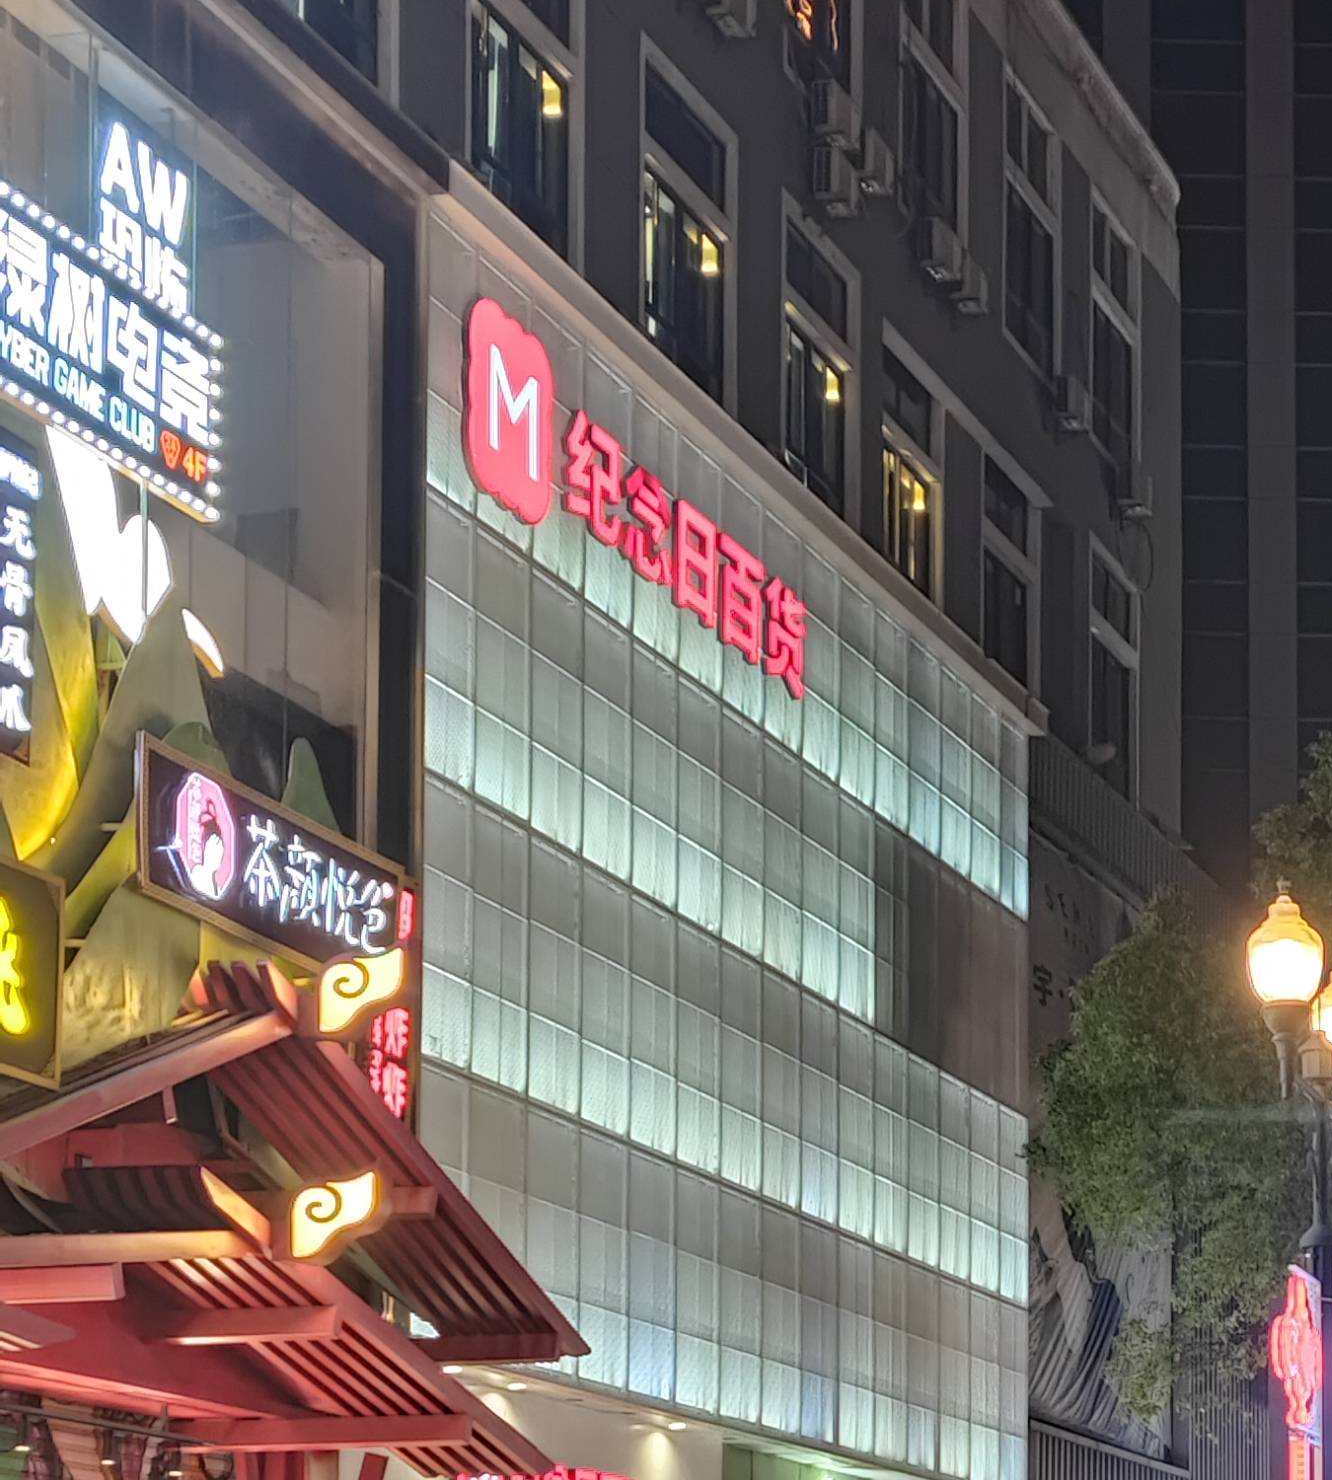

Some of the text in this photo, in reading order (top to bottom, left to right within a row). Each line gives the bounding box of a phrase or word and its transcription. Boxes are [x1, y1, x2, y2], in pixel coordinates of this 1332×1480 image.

[101, 121, 189, 245] AW
[53, 358, 106, 422] GAME
[109, 396, 157, 454] CLUB
[181, 446, 208, 484] 4F
[561, 408, 808, 701] 纪念日百货
[243, 814, 395, 954] 茶颜悦色
